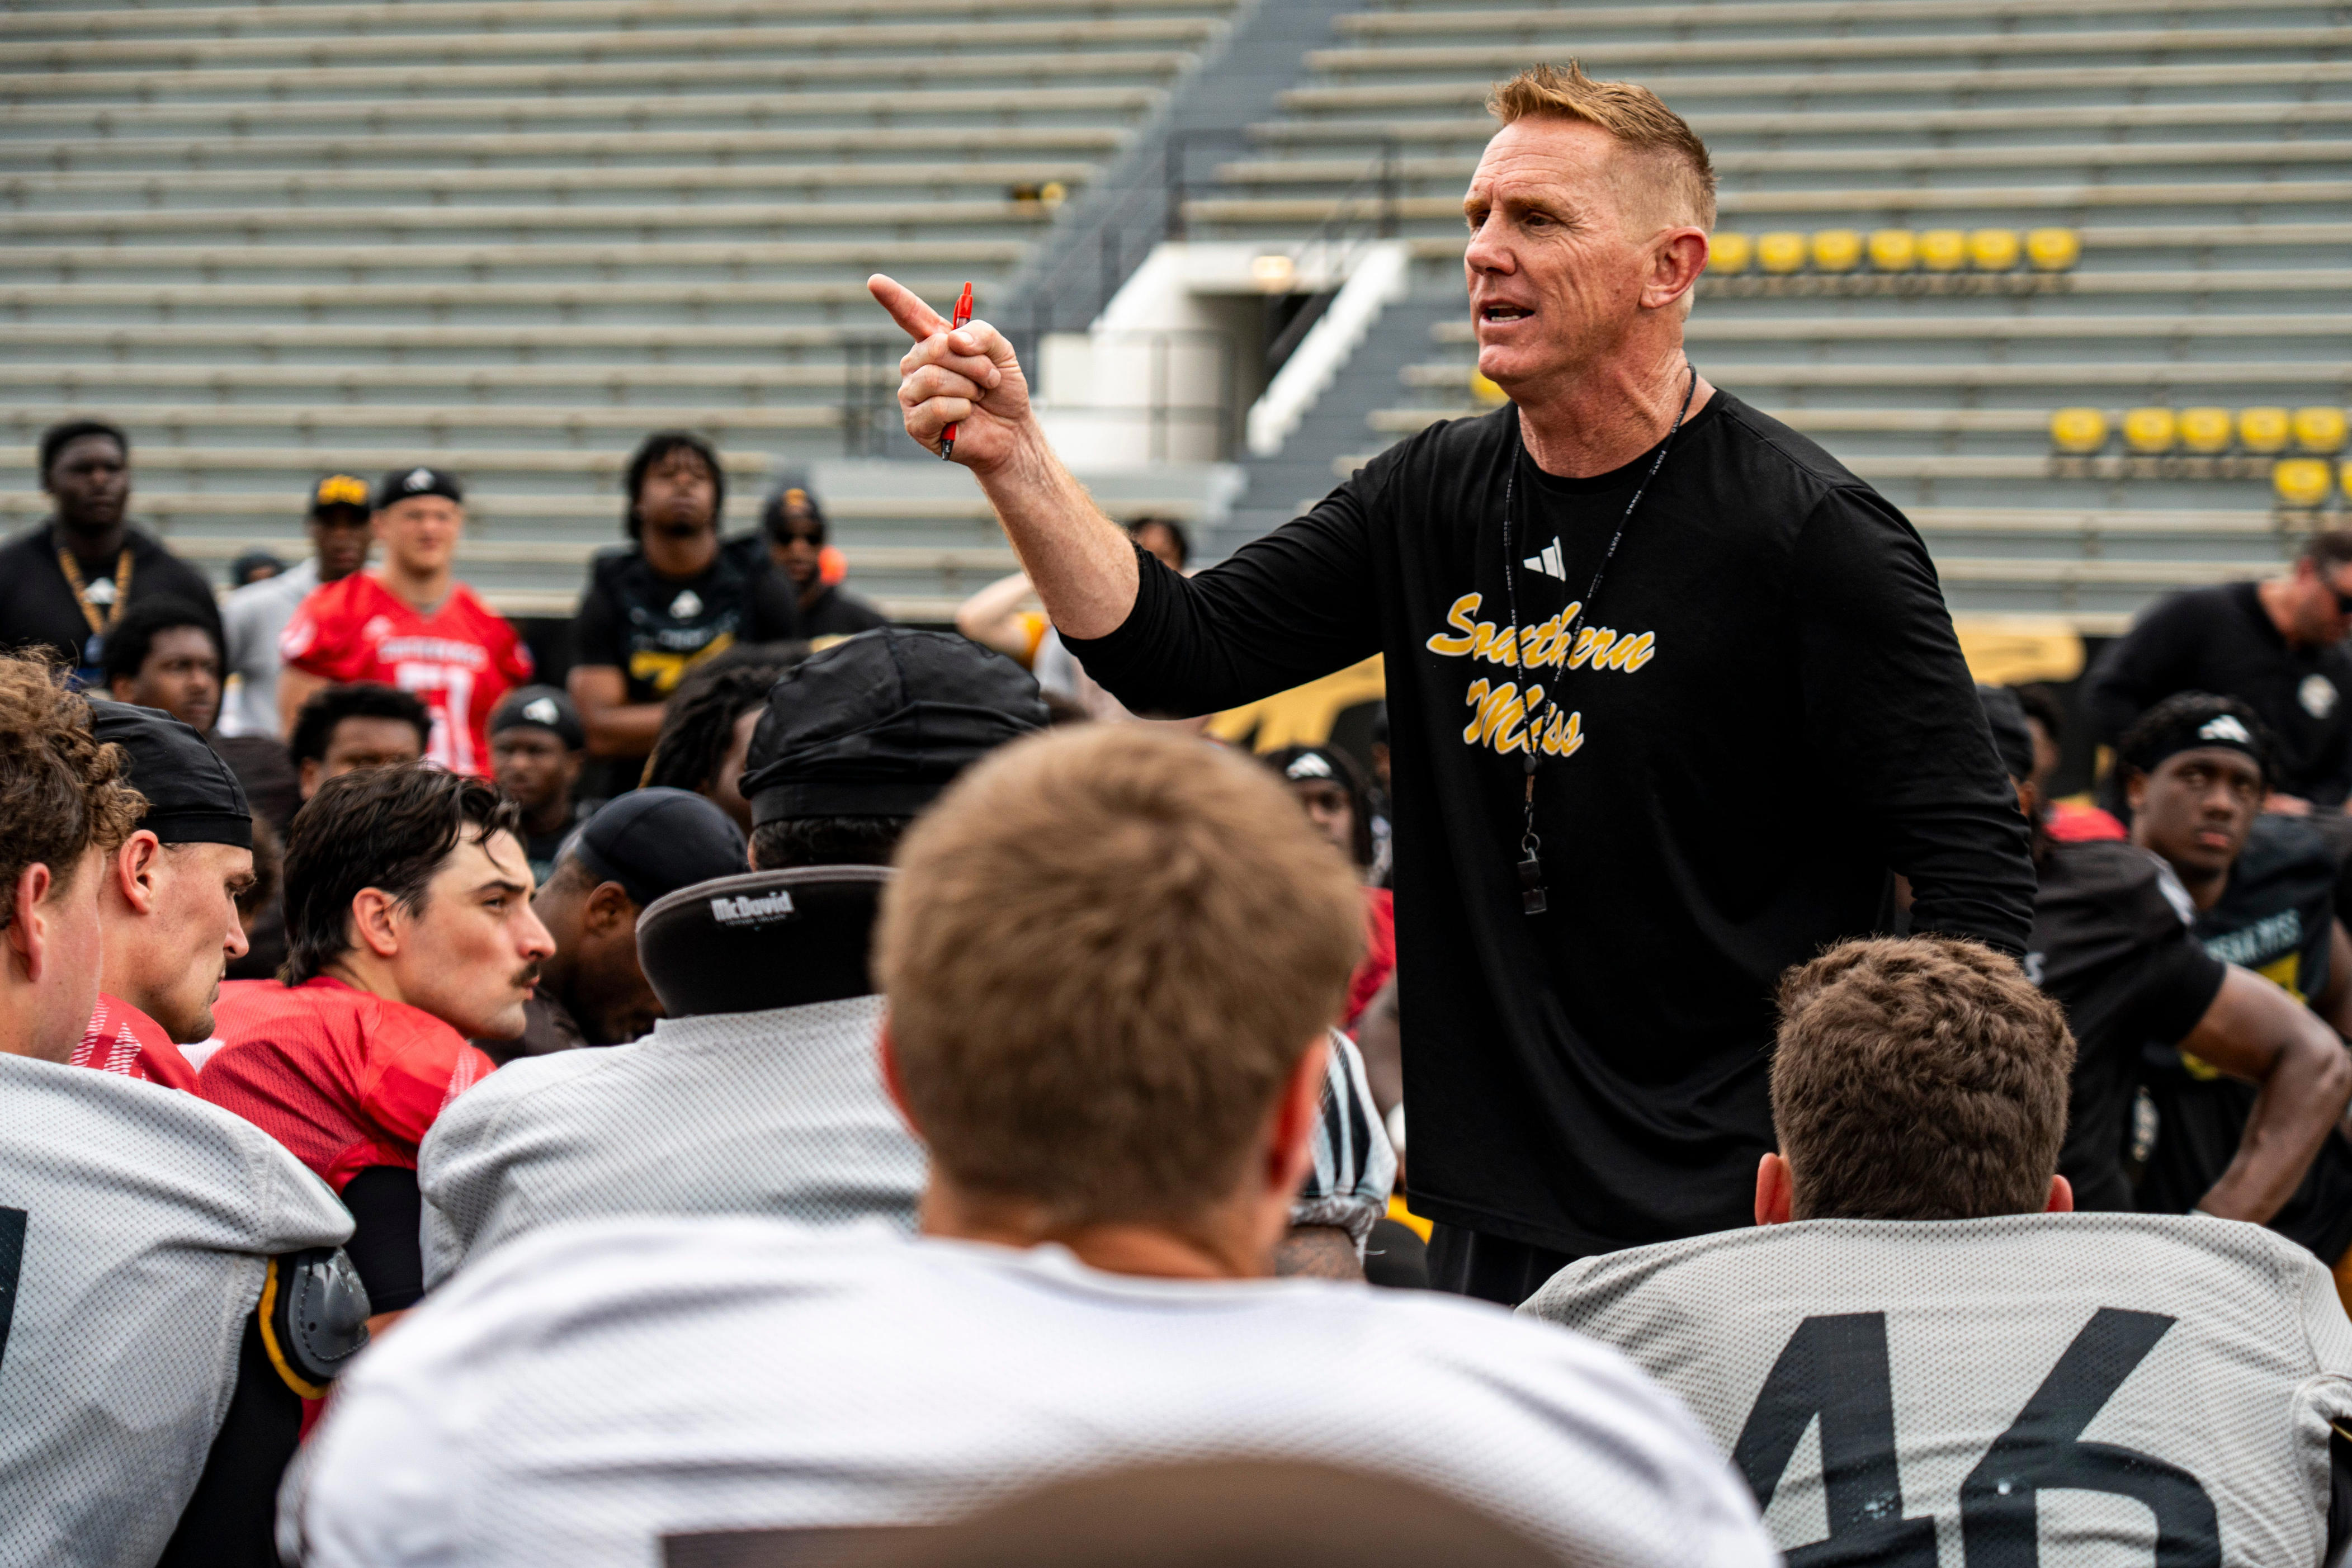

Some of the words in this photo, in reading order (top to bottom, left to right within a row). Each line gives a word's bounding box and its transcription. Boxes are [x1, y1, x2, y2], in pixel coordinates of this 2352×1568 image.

[1426, 592, 1655, 674] Southern
[1463, 677, 1585, 758] Miss
[1725, 1306, 2223, 1568] 46
